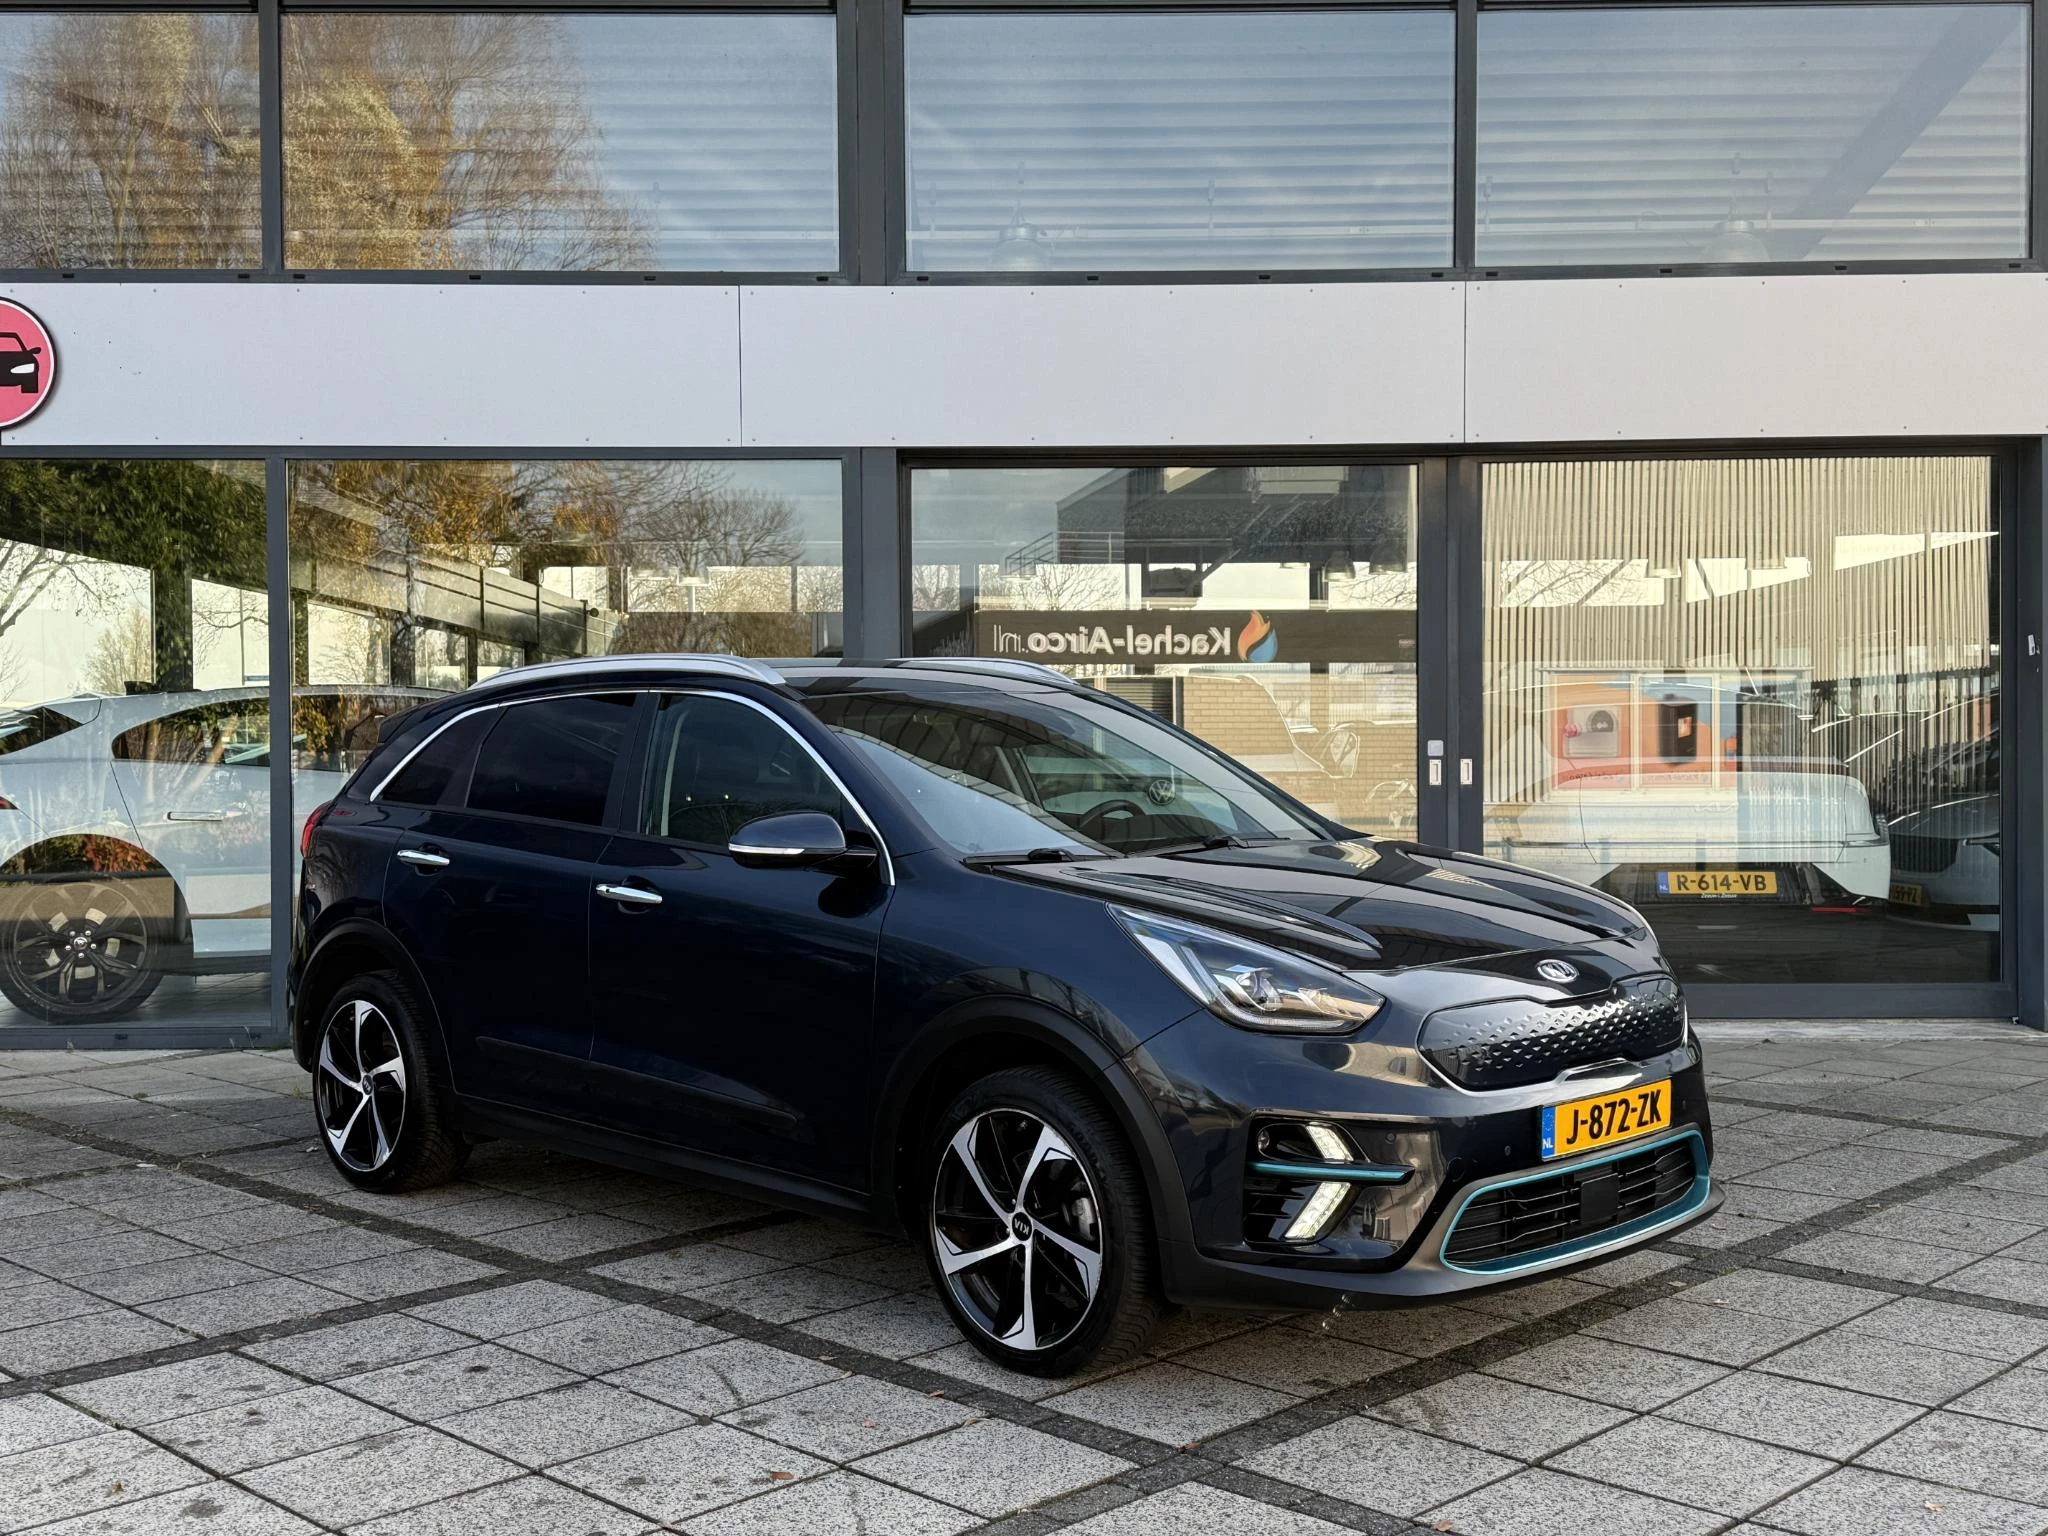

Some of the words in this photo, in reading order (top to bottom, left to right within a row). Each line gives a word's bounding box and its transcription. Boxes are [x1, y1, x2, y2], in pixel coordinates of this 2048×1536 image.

[1676, 874, 1767, 891] R-614-VB
[1542, 1137, 1554, 1149] NL
[1566, 1089, 1662, 1145] J-872-ZK
[1014, 1217, 1030, 1236] KIA
